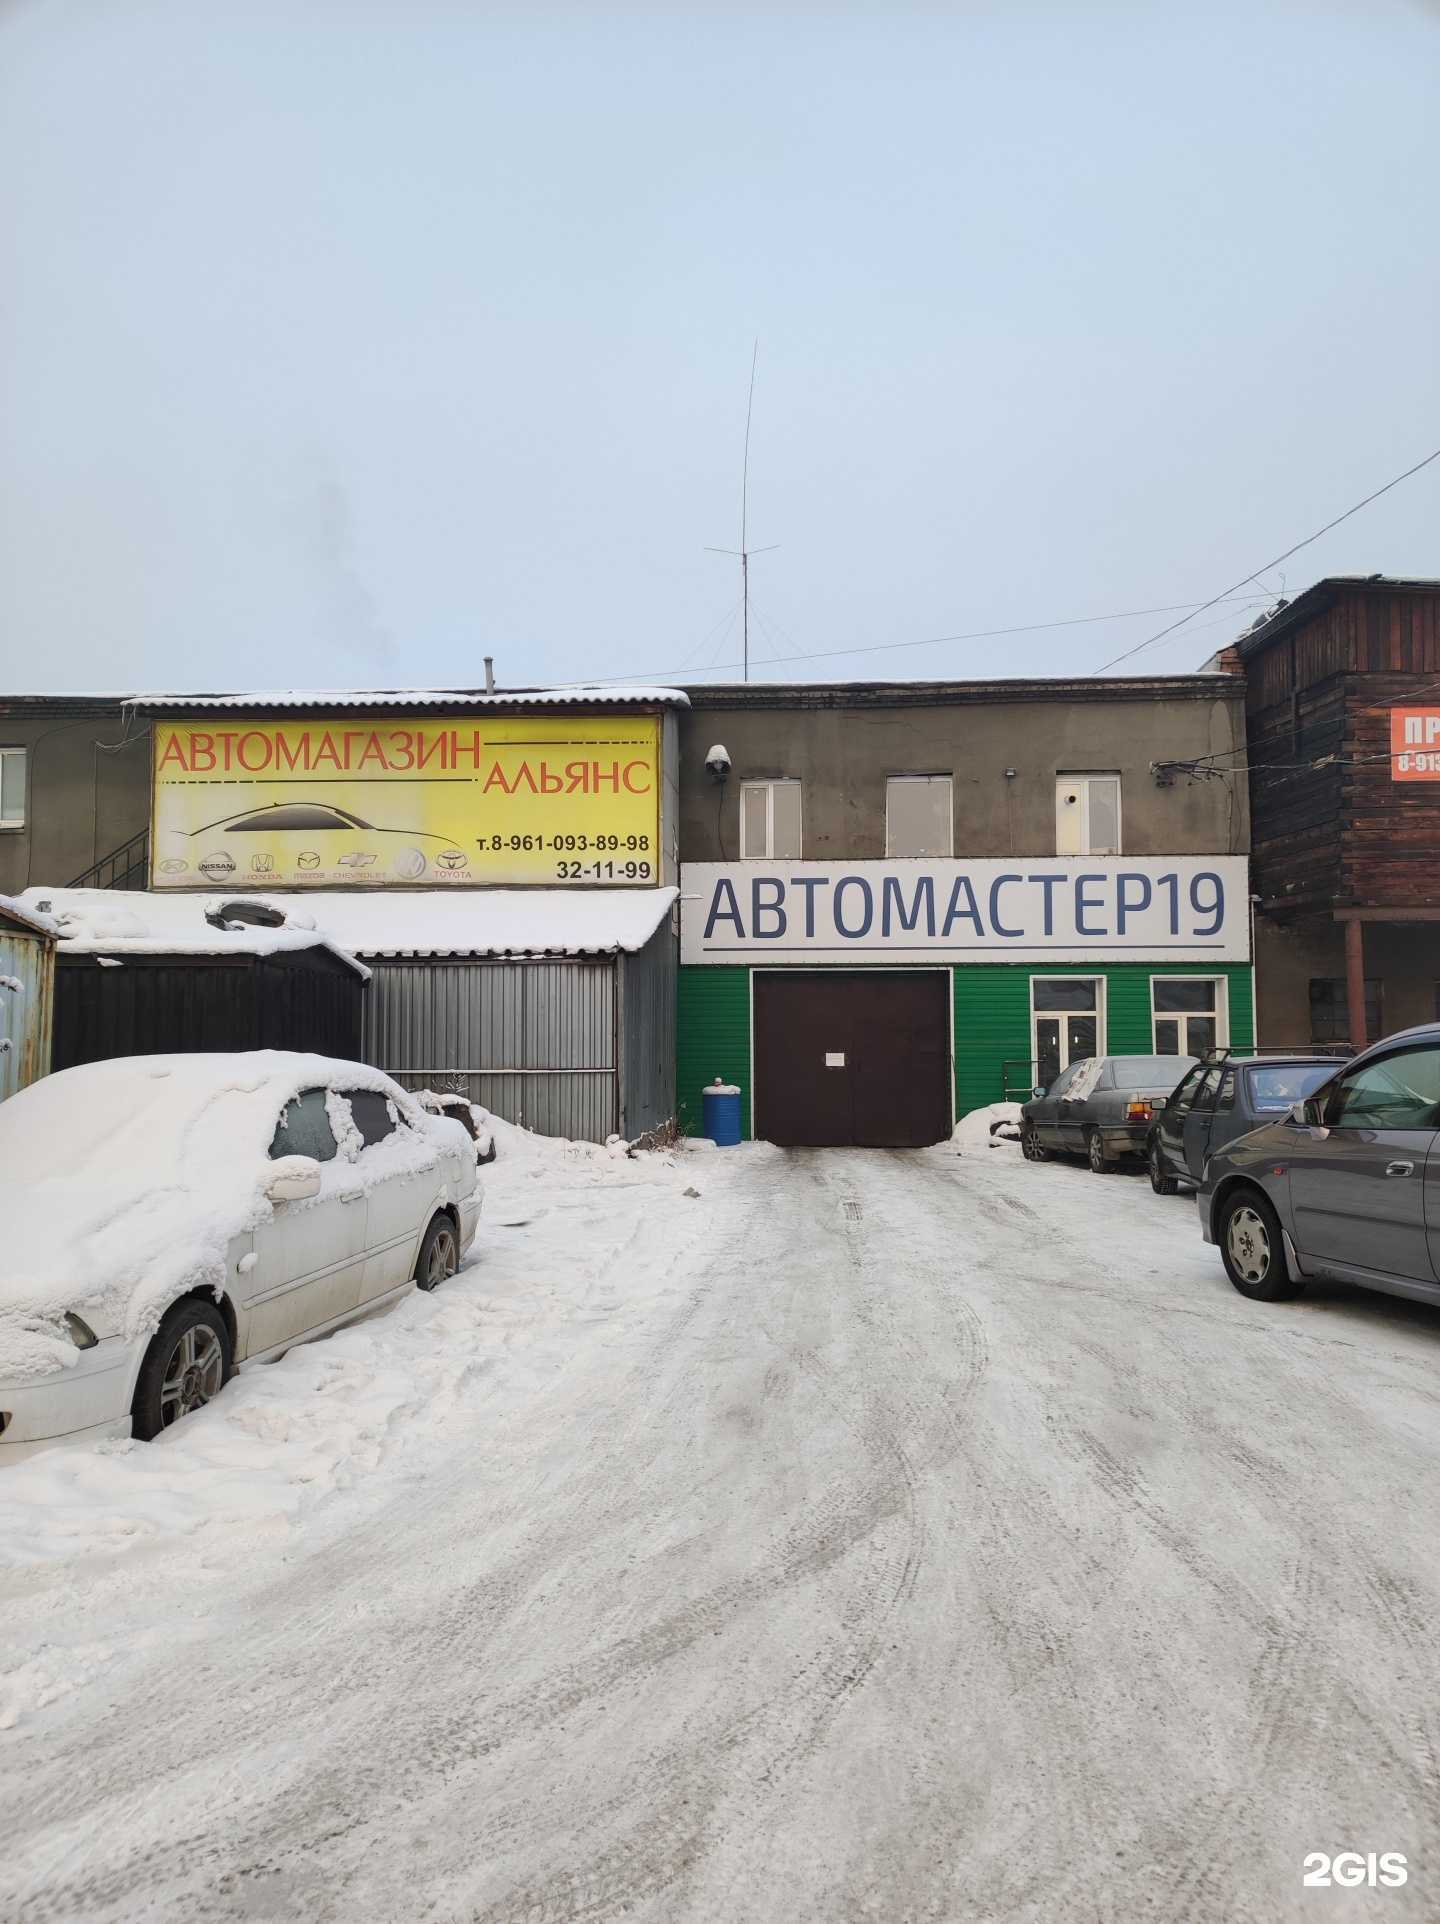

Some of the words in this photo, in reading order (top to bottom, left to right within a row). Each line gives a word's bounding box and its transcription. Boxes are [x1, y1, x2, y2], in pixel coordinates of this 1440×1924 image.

[158, 731, 480, 772] АВТОМАГАЗИН
[482, 760, 651, 794] АЛЬЯНС
[476, 835, 649, 851] т.8-961-093-89-98
[434, 870, 472, 879] TOYOTA
[556, 861, 651, 879] 32-11-99
[703, 872, 1225, 939] АВТОМАСТЕР19
